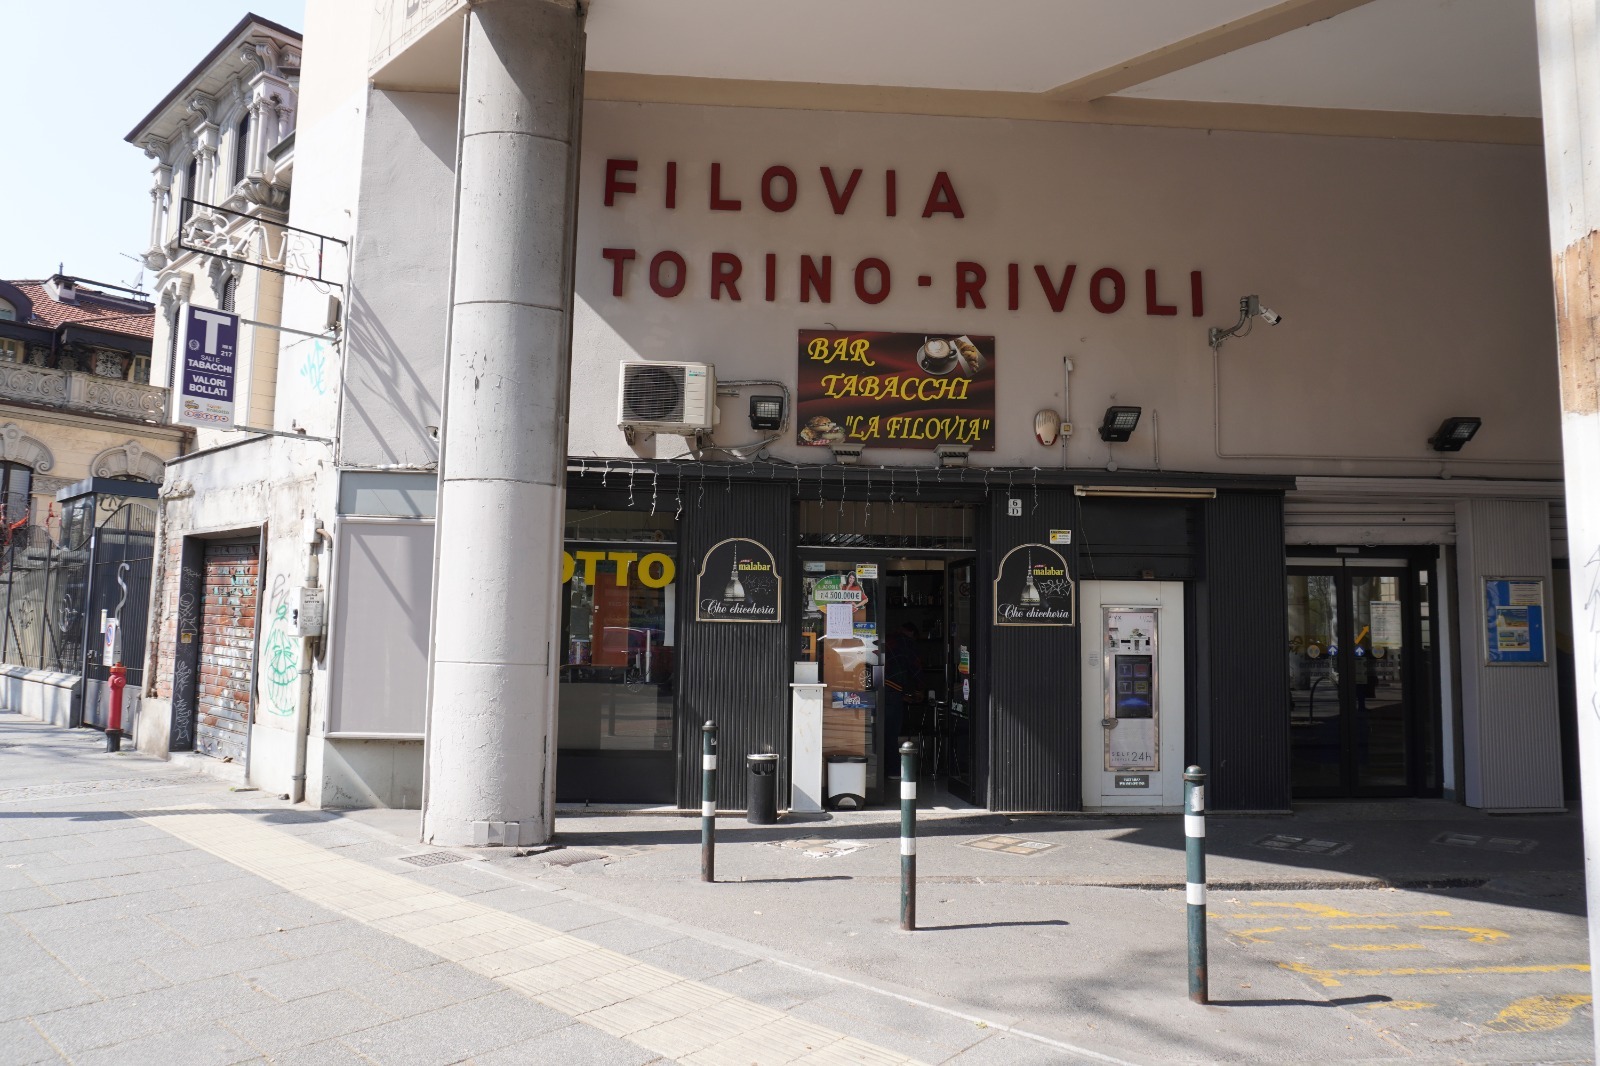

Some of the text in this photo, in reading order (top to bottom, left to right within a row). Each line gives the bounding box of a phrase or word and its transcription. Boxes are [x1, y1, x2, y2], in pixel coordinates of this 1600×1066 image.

[604, 159, 965, 219] FILOVIA
[194, 309, 231, 355] T
[200, 354, 215, 362] SALI
[220, 350, 233, 358] 217
[807, 337, 876, 367] BAR
[187, 358, 233, 374] TABACCHI
[192, 374, 226, 388] VALORI
[820, 373, 973, 401] TABACCHI
[188, 383, 228, 397] BOLLATI
[845, 415, 990, 444] "LA FILOVIA"
[738, 561, 771, 571] malabar
[1033, 566, 1065, 576] malabar
[1131, 751, 1152, 762] 24h
